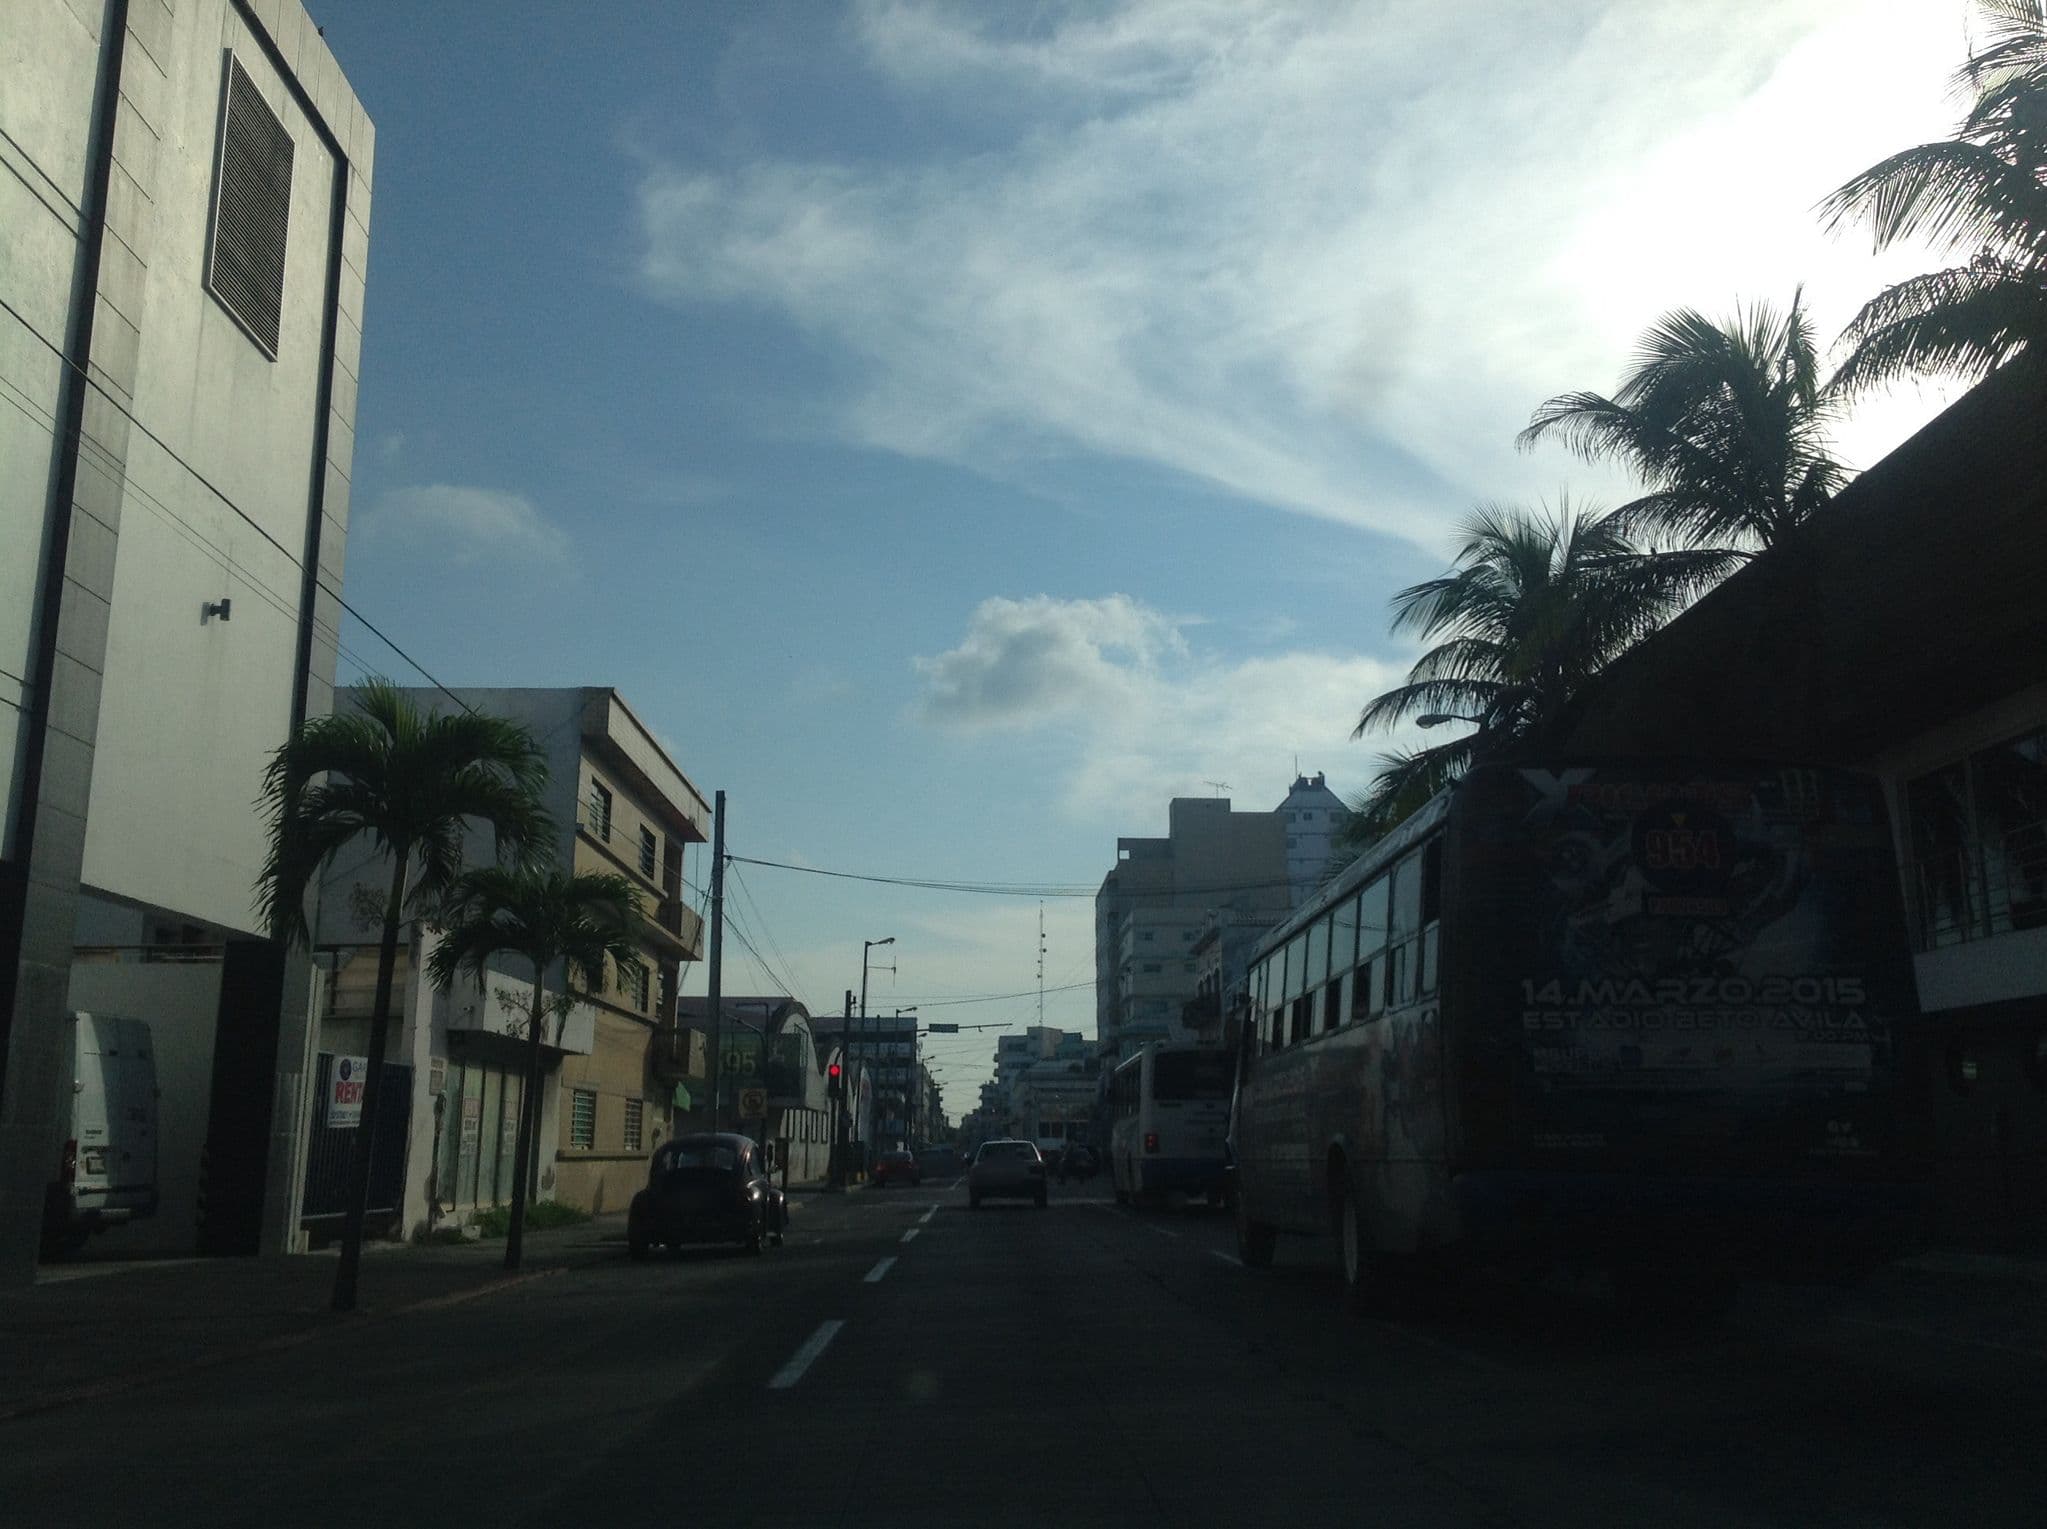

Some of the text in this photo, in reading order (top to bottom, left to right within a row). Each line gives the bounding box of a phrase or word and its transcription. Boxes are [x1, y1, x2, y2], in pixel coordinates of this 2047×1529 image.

[1522, 1010, 1868, 1030] ESTADIO BETO AVILA
